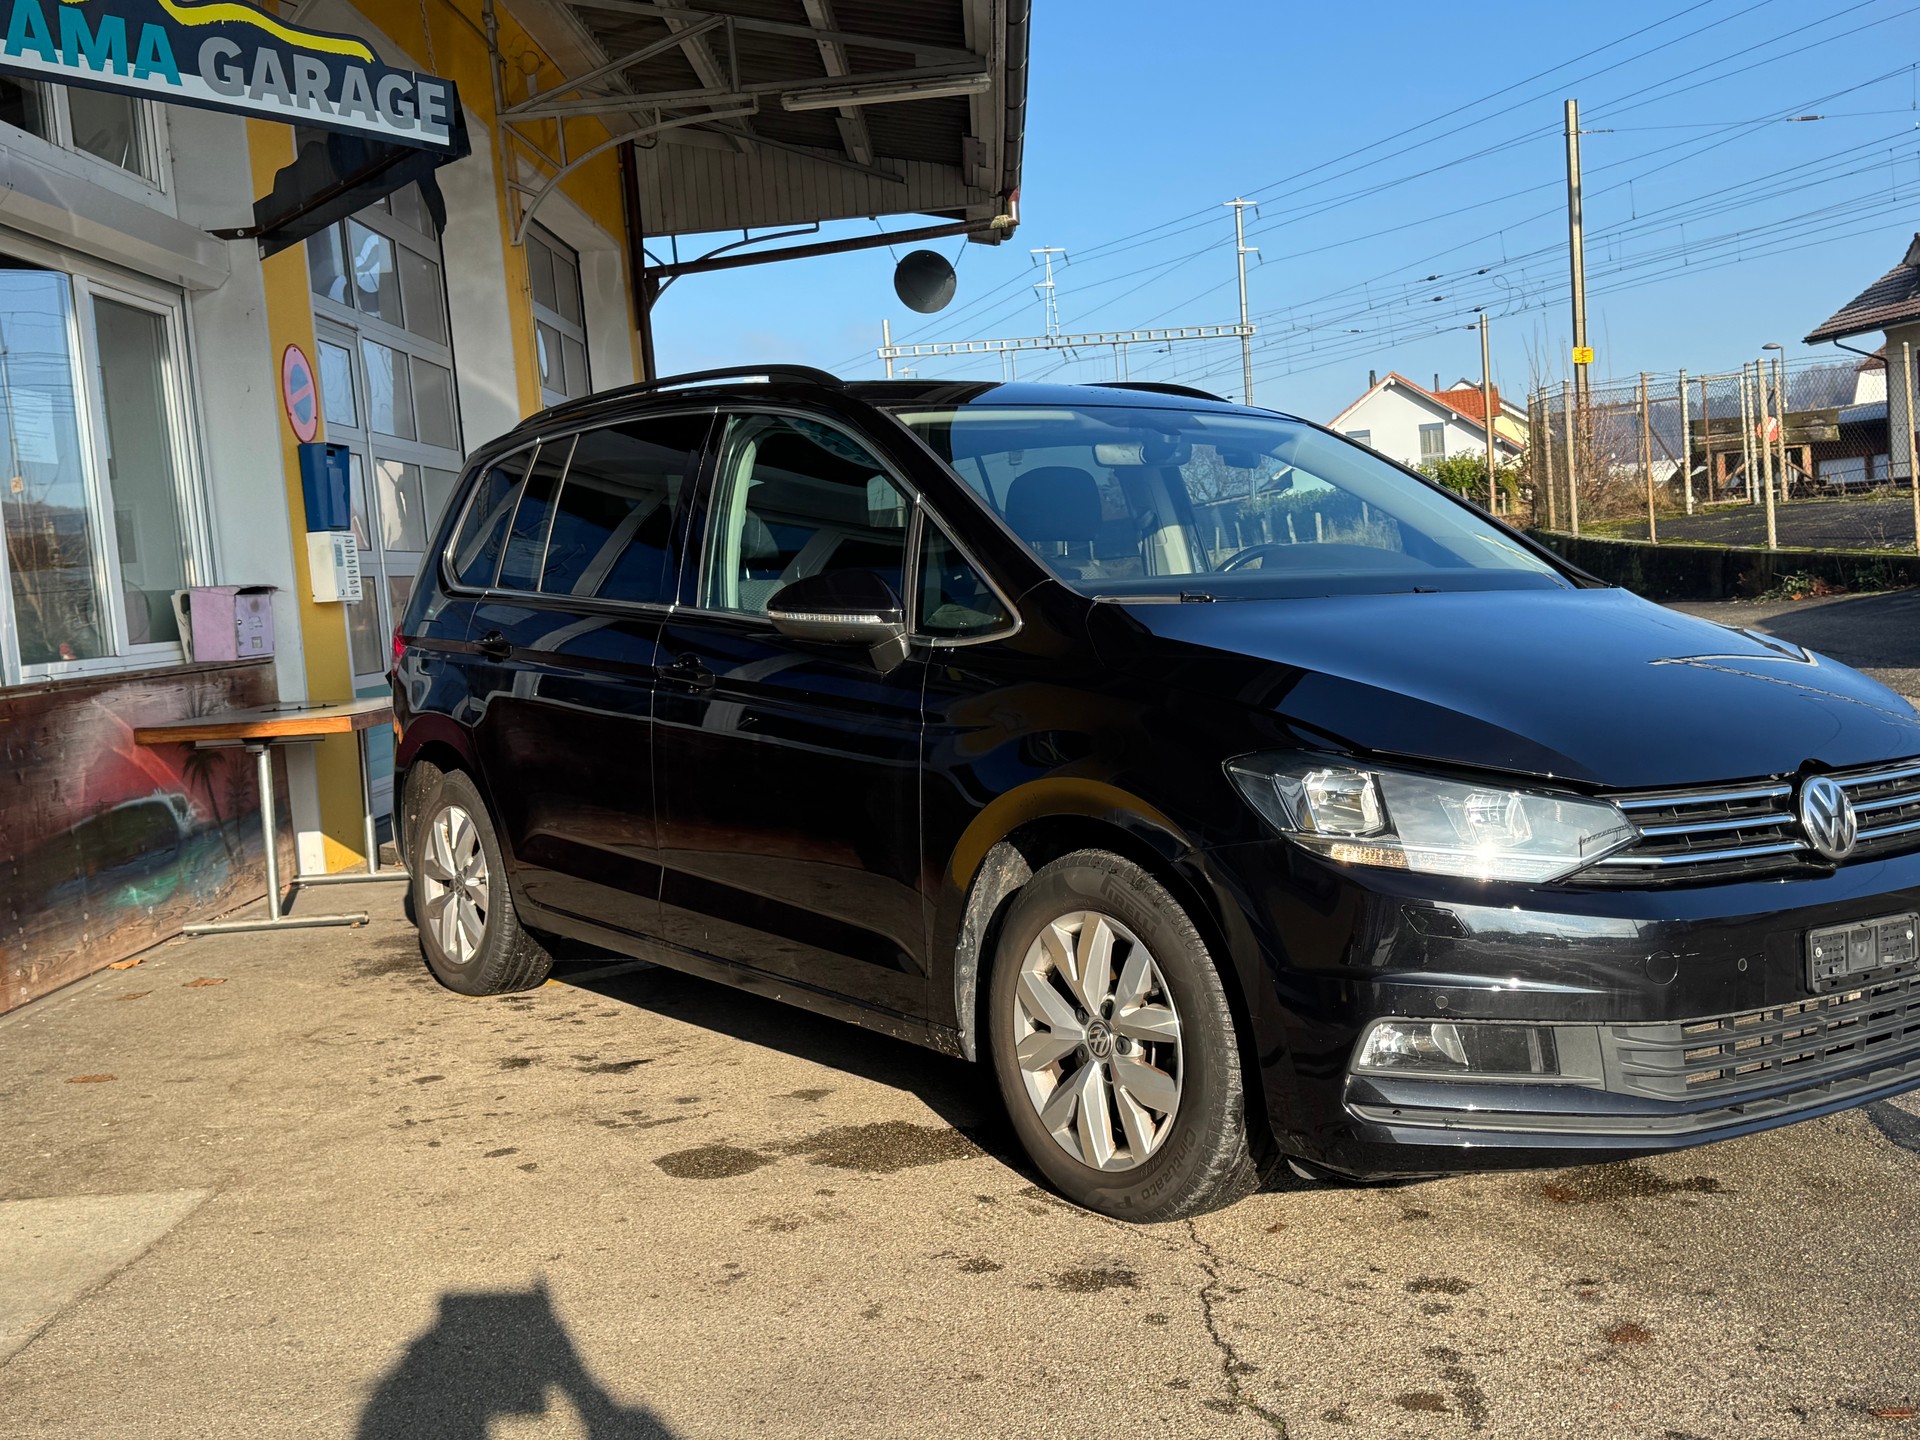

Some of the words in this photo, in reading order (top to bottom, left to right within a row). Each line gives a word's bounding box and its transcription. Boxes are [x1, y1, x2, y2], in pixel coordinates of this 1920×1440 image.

[4, 0, 183, 86] AMA
[198, 36, 449, 137] GARAGE
[1100, 874, 1162, 937] PIRELLI
[1141, 1127, 1197, 1200] Cinturato
